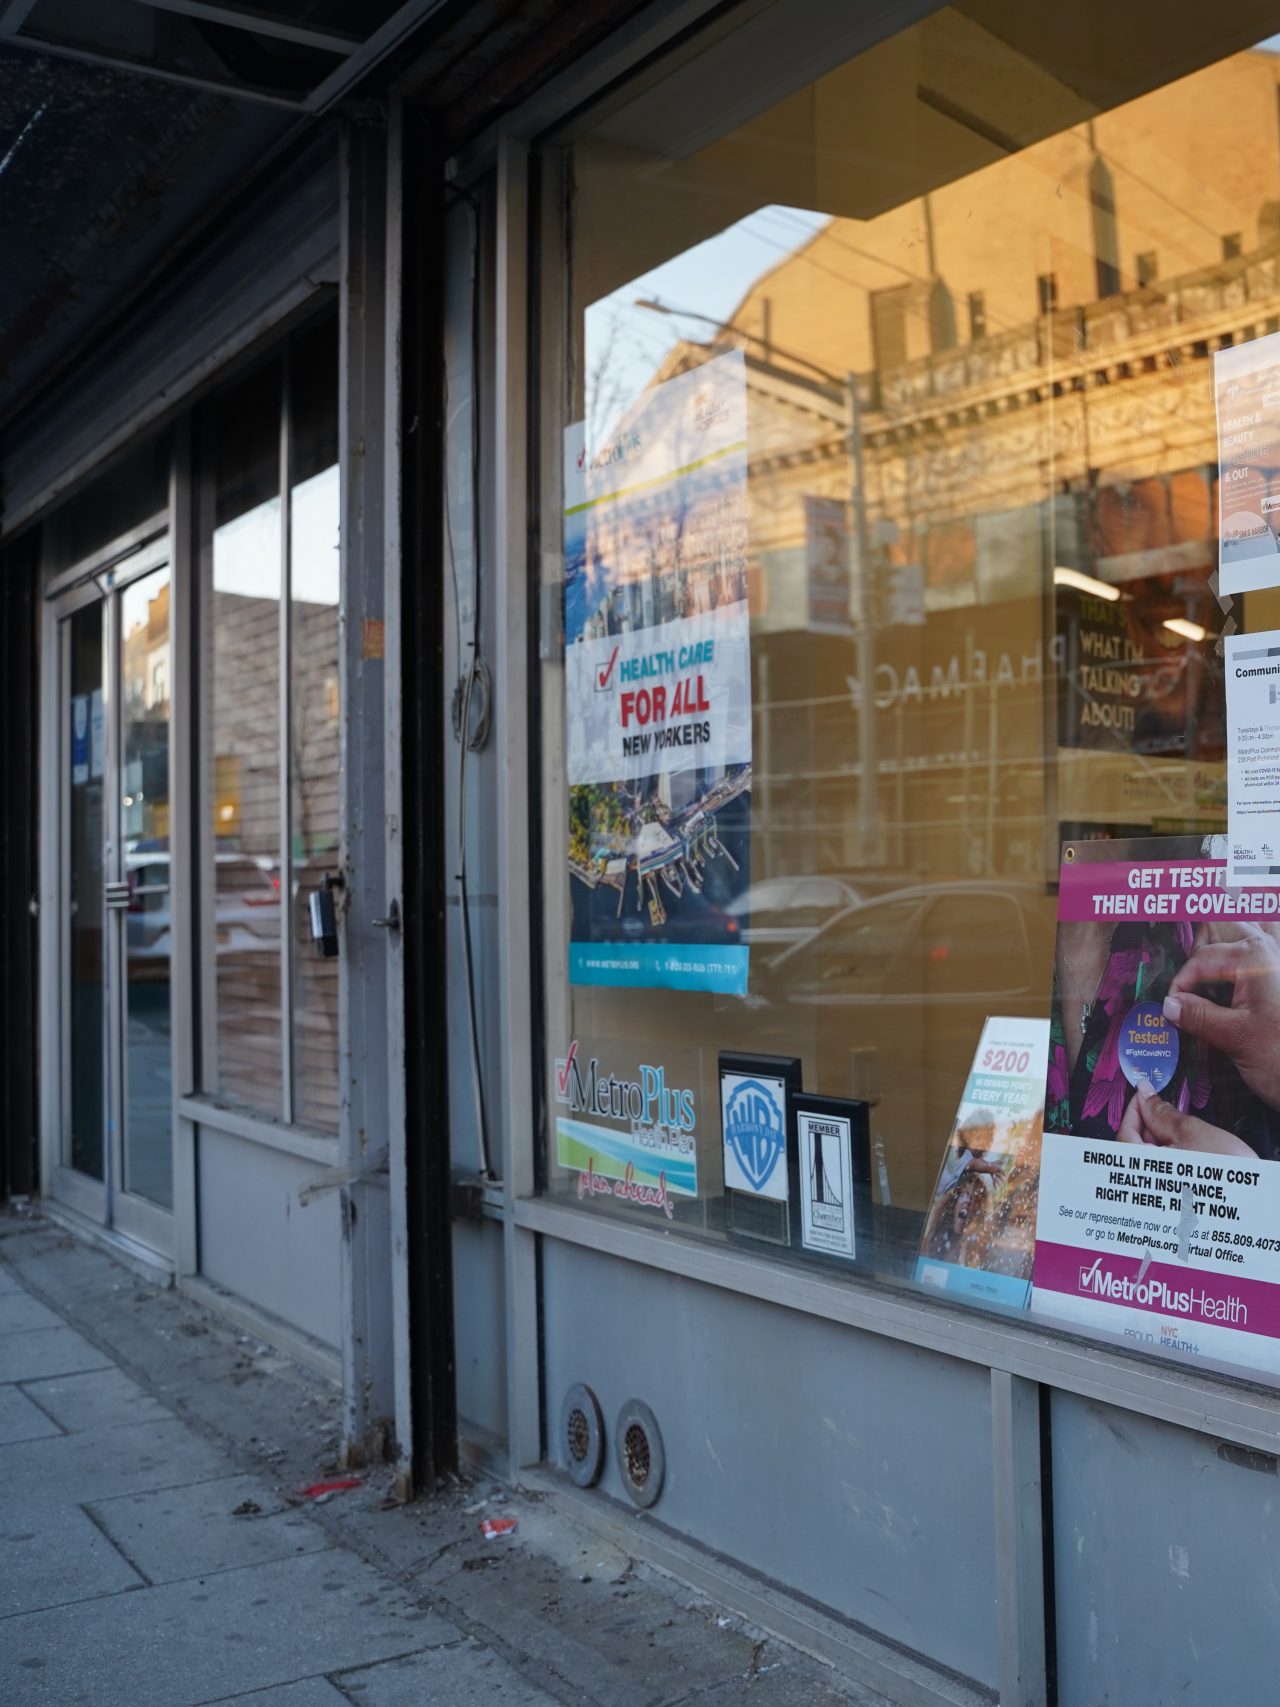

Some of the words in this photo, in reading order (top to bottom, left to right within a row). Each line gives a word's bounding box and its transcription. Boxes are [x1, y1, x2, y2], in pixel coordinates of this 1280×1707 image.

[1223, 415, 1253, 433] HEALTH
[1223, 431, 1255, 448] BEAUTY
[1232, 467, 1249, 480] OUT
[1080, 630, 1120, 659] WHAT
[620, 650, 675, 682] HEALTH
[679, 640, 714, 669] CARE
[1080, 665, 1140, 697] TALKING
[620, 686, 666, 728] FOR
[670, 675, 710, 718] ALL
[1081, 702, 1135, 731] ABOUT!
[623, 733, 651, 757] NEW
[655, 721, 710, 751] YORKERS
[1128, 868, 1164, 888] GET
[1169, 867, 1227, 888] TEST
[1092, 894, 1139, 914] THEN
[1143, 894, 1180, 914] GET
[1137, 1013, 1141, 1027] I
[1144, 1013, 1165, 1027] Got
[1128, 1029, 1170, 1045] Tested!
[982, 1048, 1030, 1073] $200
[569, 1057, 696, 1132] MetroPlus
[971, 1088, 1001, 1103] EVERY
[808, 1122, 841, 1135] MEMBER
[1083, 1151, 1125, 1168] ENROLL
[1129, 1156, 1140, 1170] IN
[1143, 1159, 1173, 1174] FREE
[1176, 1163, 1193, 1177] OR
[1197, 1165, 1223, 1181] LOW
[1226, 1169, 1260, 1186] COST
[1109, 1171, 1151, 1189] HEALTH
[1095, 1186, 1129, 1203] RIGHT
[1132, 1192, 1166, 1212] HERE,
[1169, 1198, 1205, 1215] RIHT
[1209, 1203, 1240, 1220] NOW.
[1059, 1205, 1073, 1217] See
[1075, 1209, 1087, 1220] our
[1089, 1212, 1142, 1229] representative
[1143, 1221, 1160, 1232] now
[1162, 1224, 1172, 1234] or
[1201, 1230, 1210, 1241] at
[1085, 1227, 1095, 1237] or
[1095, 1231, 1105, 1241] go
[1107, 1230, 1115, 1240] to
[1187, 1243, 1213, 1258] irtual
[1215, 1248, 1245, 1264] Office.
[1094, 1268, 1248, 1325] MetroPlusHealth
[1124, 1328, 1154, 1344] PROUD
[1160, 1325, 1179, 1338] NYC
